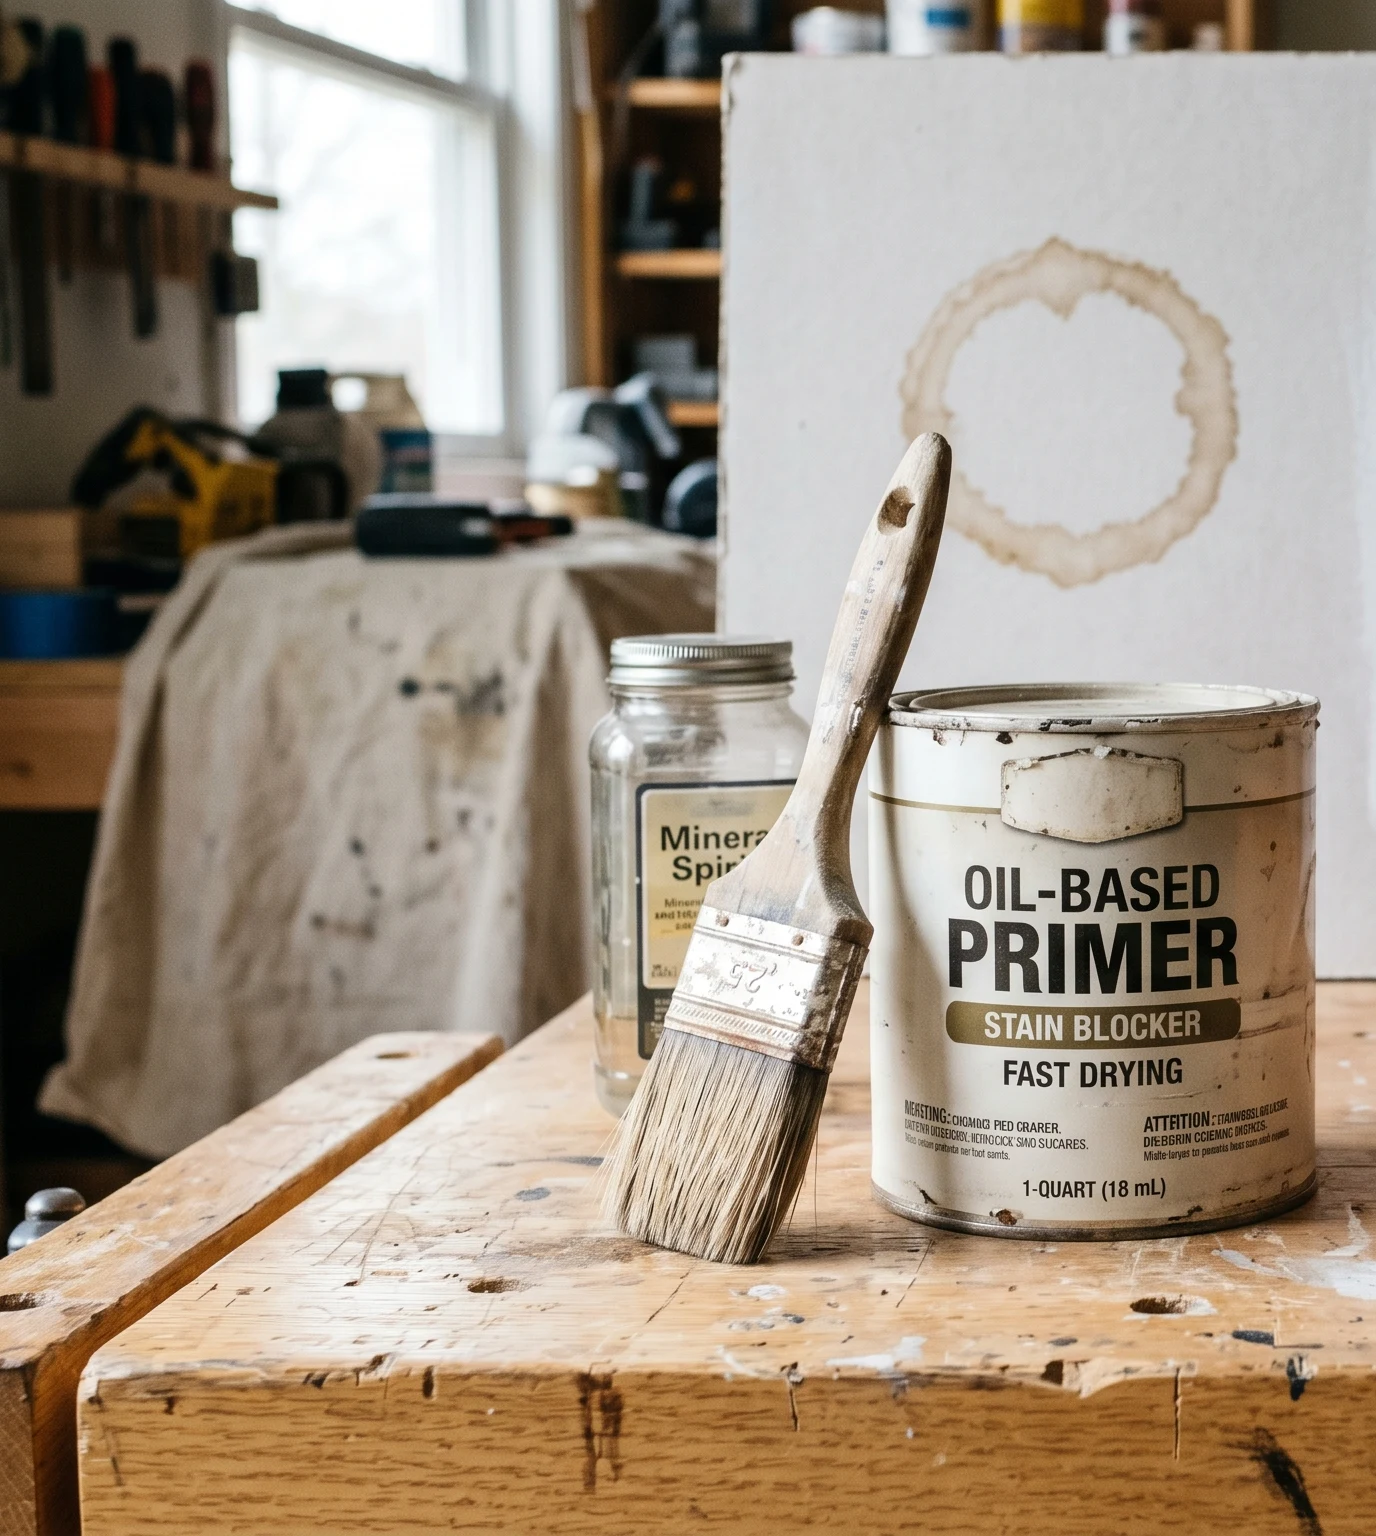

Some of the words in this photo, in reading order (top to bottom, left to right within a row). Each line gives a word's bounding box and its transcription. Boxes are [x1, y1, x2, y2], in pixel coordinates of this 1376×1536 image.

[660, 825, 769, 851] Minera
[964, 863, 1220, 913] OIL-BASED
[948, 917, 1240, 995] PRIMER
[984, 1011, 1063, 1041] STAIN
[1073, 1010, 1202, 1042] BLOCKER
[1003, 1059, 1071, 1088] FAST
[1080, 1057, 1183, 1088] DRYING
[1022, 1179, 1097, 1200] 1-QUART
[1101, 1179, 1129, 1202] (18
[1134, 1178, 1167, 1201] mL)
